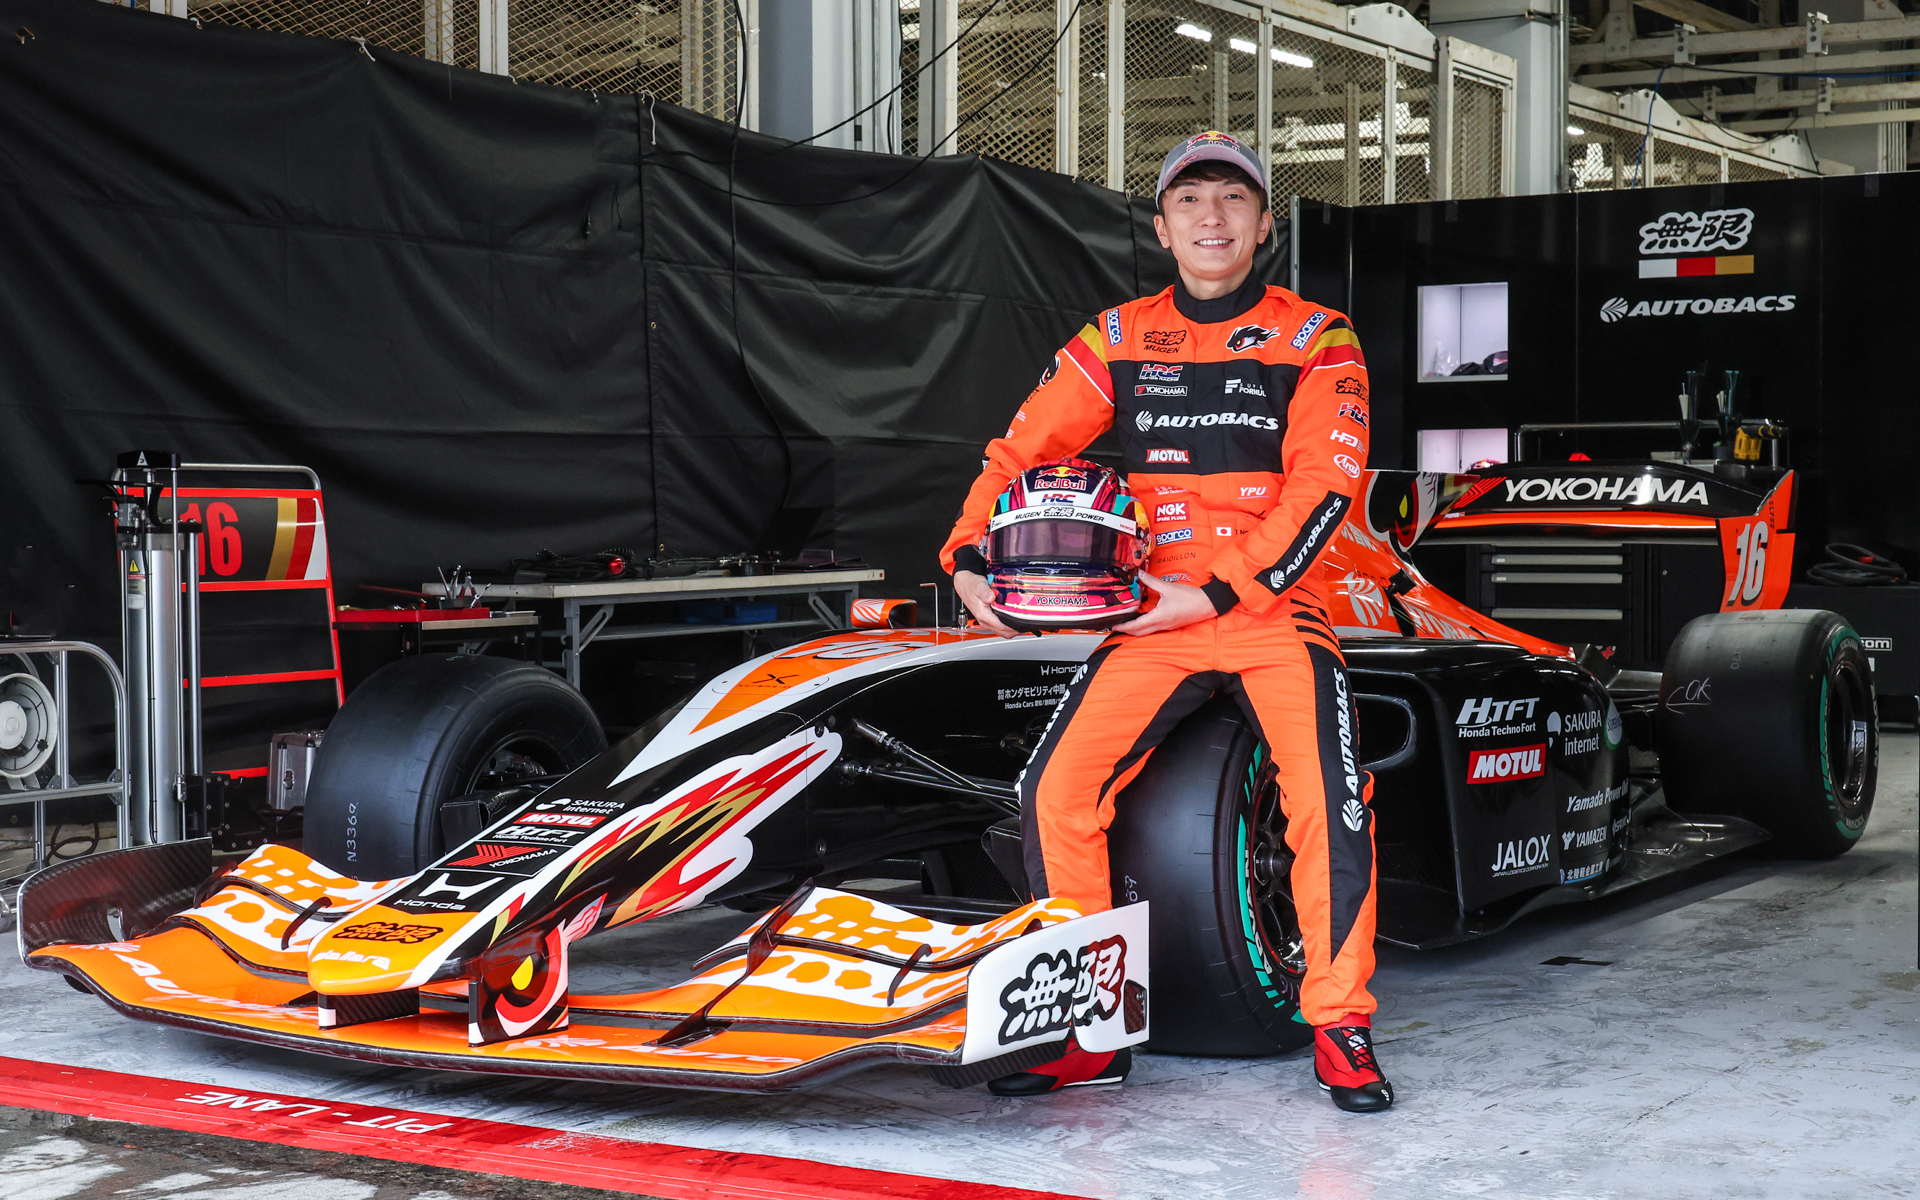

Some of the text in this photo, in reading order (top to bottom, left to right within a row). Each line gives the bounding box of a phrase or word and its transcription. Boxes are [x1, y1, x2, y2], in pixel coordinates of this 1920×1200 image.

[1639, 208, 1755, 254] 無限
[1628, 295, 1796, 317] AUTOBACS
[1291, 311, 1325, 349] sparco
[1143, 345, 1180, 353] MUGEN
[1140, 364, 1183, 378] HRC
[1146, 386, 1186, 395] YOKOHAMA
[1154, 412, 1279, 431] AUTOBACS
[1148, 450, 1189, 463] MOTUL
[1340, 457, 1358, 475] Arai
[1035, 479, 1086, 490] Red Bull
[1239, 487, 1267, 496] YPU
[1505, 477, 1709, 506] YOKOHAMA
[1041, 494, 1076, 503] HRC
[1014, 511, 1041, 520] MUGEN
[1075, 512, 1105, 522] POWER
[1156, 502, 1186, 517] NGK
[180, 501, 243, 577] 16
[1157, 528, 1192, 544] sparco
[1286, 498, 1342, 576] AUTOBACS
[1157, 552, 1196, 564] RAIDILLON
[1727, 521, 1769, 605] 16
[1035, 596, 1089, 606] YOKOHAMA
[1455, 697, 1540, 726] HTFT
[1564, 710, 1602, 733] SAKURA
[1333, 667, 1359, 797] AUTOBACS
[1458, 725, 1490, 738] Honda
[1564, 733, 1600, 756] internet
[1472, 749, 1542, 778] MOTUL
[563, 805, 614, 815] internet
[571, 799, 626, 809] SAKURA
[1566, 789, 1604, 813] Yamada
[520, 813, 597, 826] MOTUL
[496, 826, 586, 839] HTFT
[489, 848, 558, 868] YOKOHAMA
[1491, 834, 1551, 872] JALOX
[394, 898, 466, 911] Honda
[312, 949, 391, 970] dallara
[998, 934, 1127, 1046] 無限
